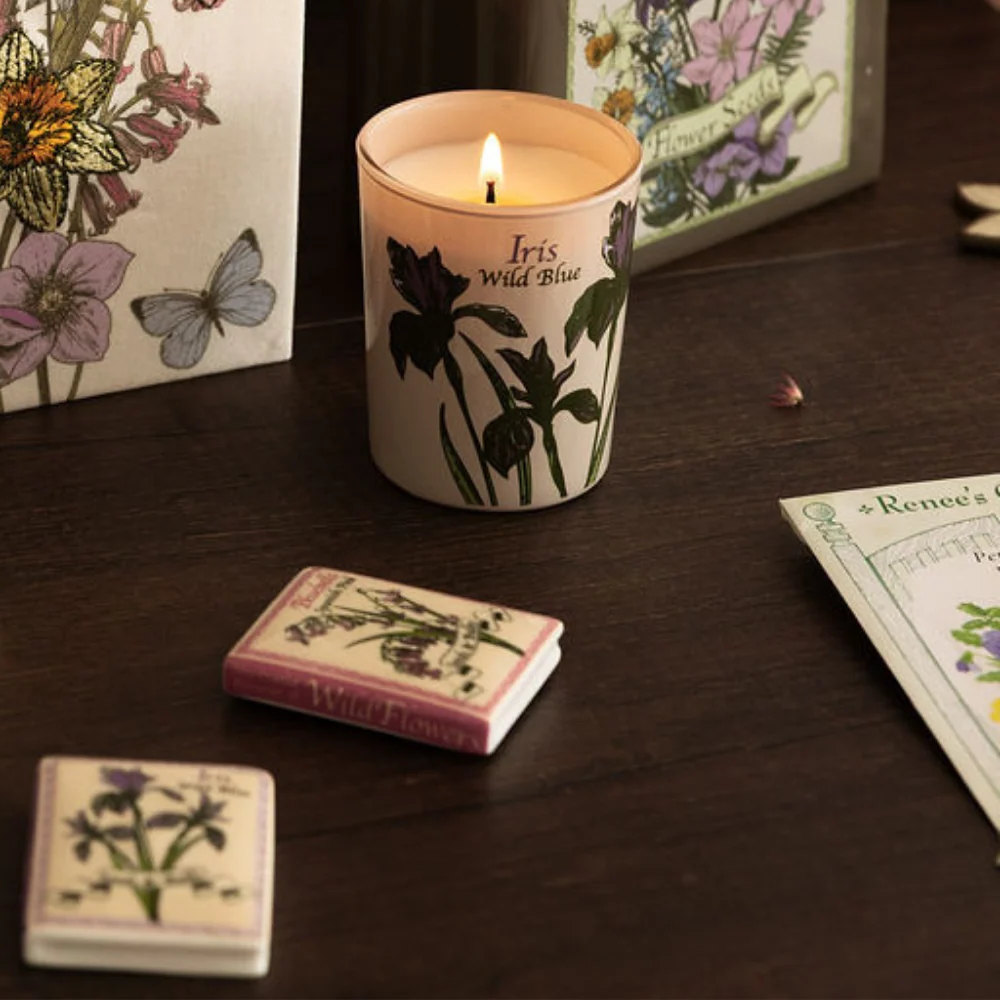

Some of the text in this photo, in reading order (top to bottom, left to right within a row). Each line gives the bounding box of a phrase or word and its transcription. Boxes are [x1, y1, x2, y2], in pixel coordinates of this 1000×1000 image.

[507, 233, 558, 264] Iris
[479, 261, 582, 288] Wild Blue
[876, 486, 988, 514] Renee's
